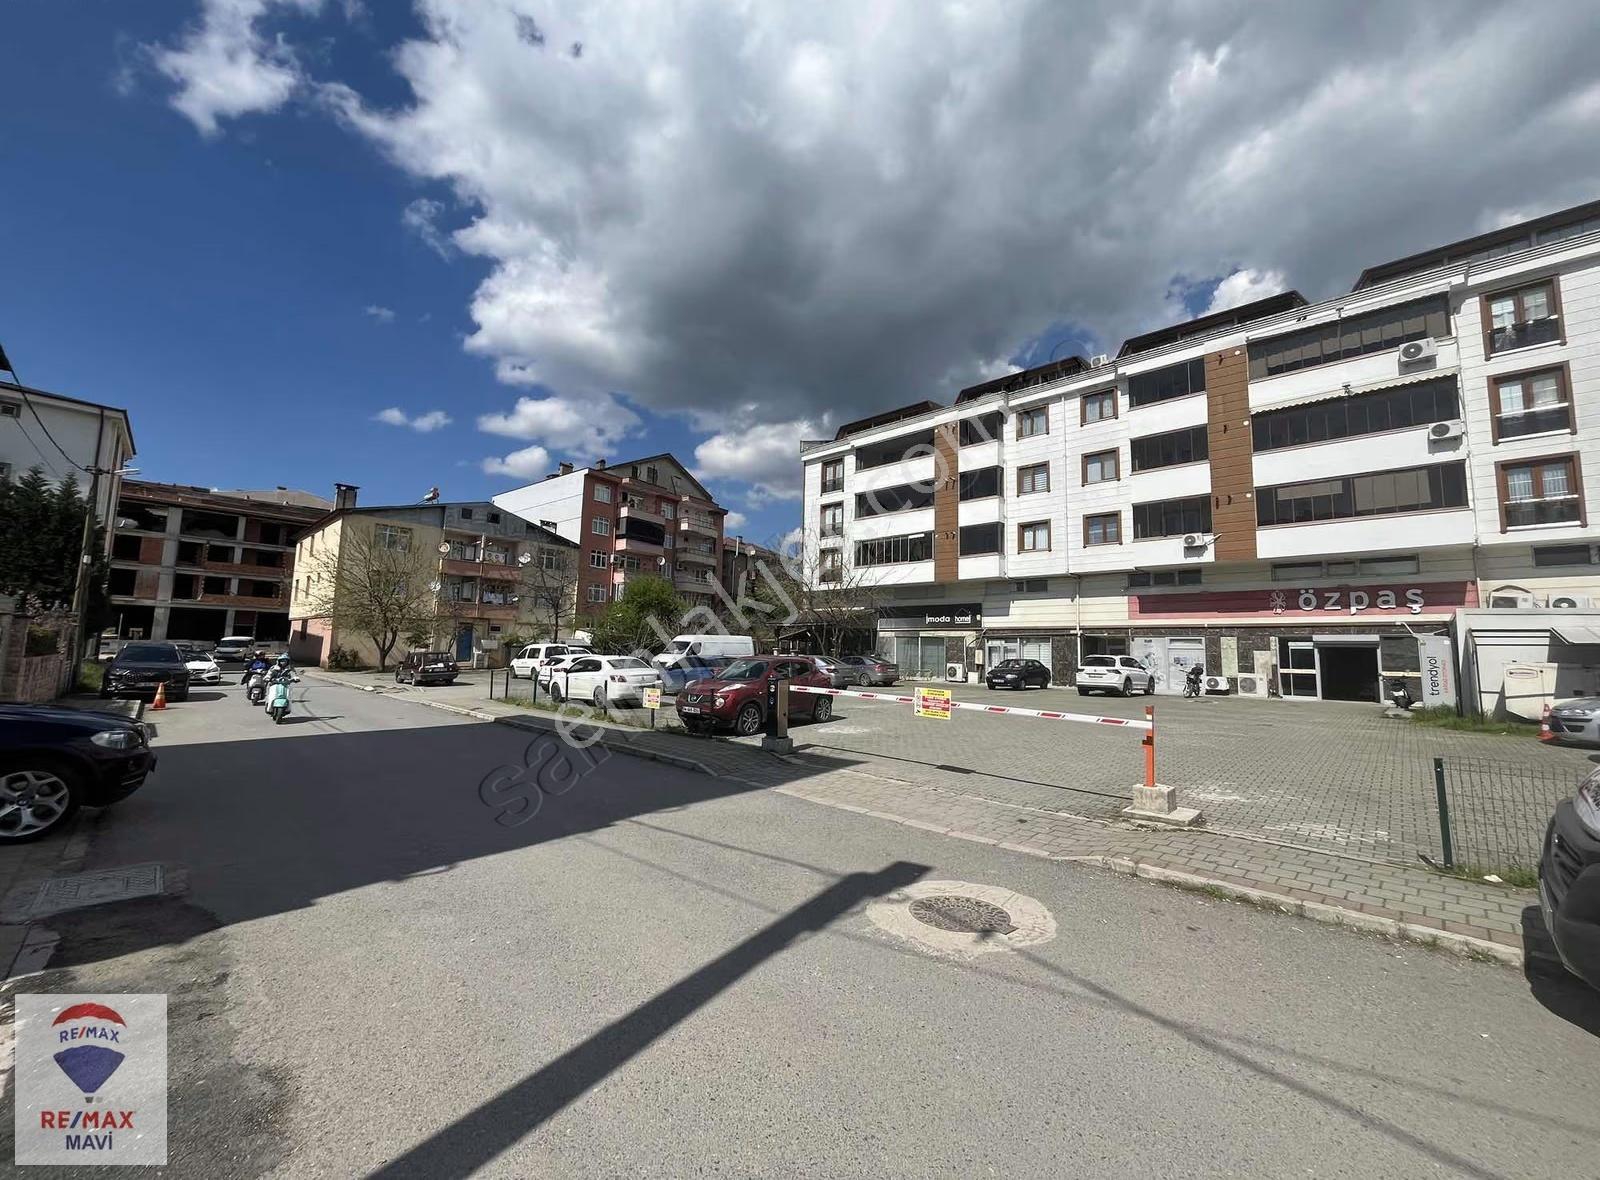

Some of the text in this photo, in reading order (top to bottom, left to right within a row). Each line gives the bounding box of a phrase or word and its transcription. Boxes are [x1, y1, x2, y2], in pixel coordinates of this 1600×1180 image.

[1298, 588, 1425, 615] özpaş
[926, 614, 950, 623] moda
[1427, 656, 1440, 696] trendyol
